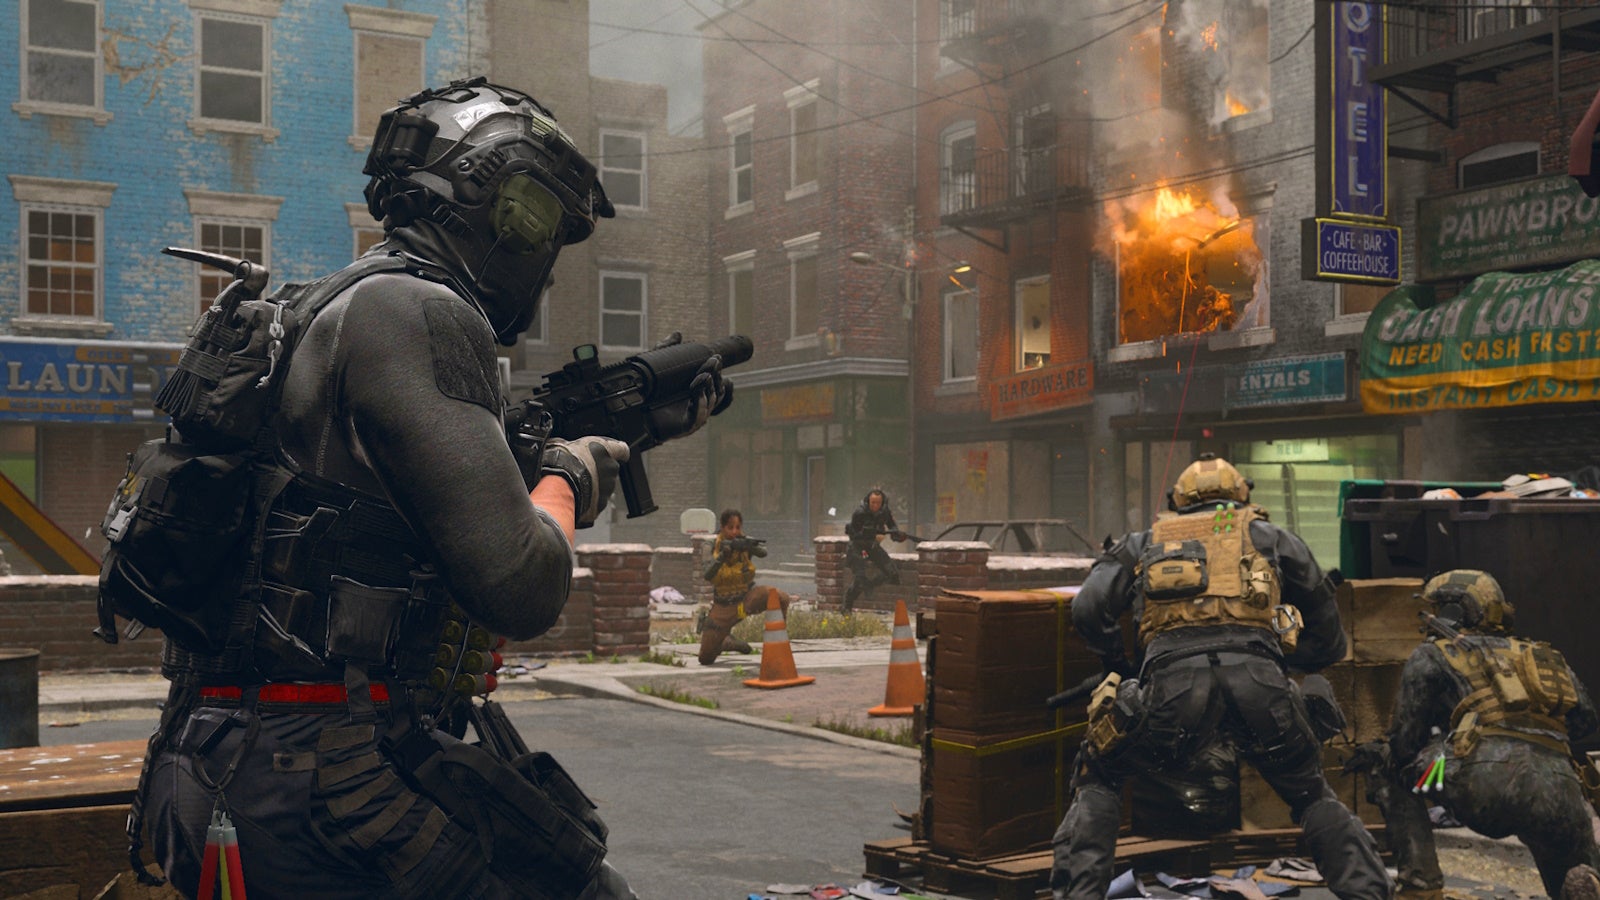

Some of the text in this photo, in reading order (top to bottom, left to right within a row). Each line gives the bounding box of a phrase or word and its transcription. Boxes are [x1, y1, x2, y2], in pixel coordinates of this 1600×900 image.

[1438, 192, 1600, 246] PAWNBRO
[1333, 230, 1382, 252] CAFE BAR
[1323, 250, 1389, 274] COFFEEHOUSE
[1378, 285, 1596, 342] CASH LOANS
[1389, 342, 1444, 366] NEED
[1461, 337, 1521, 361] CASH
[999, 367, 1088, 403] HARDWARE
[1389, 384, 1494, 409] INSTANT
[1507, 378, 1580, 402] CASH
